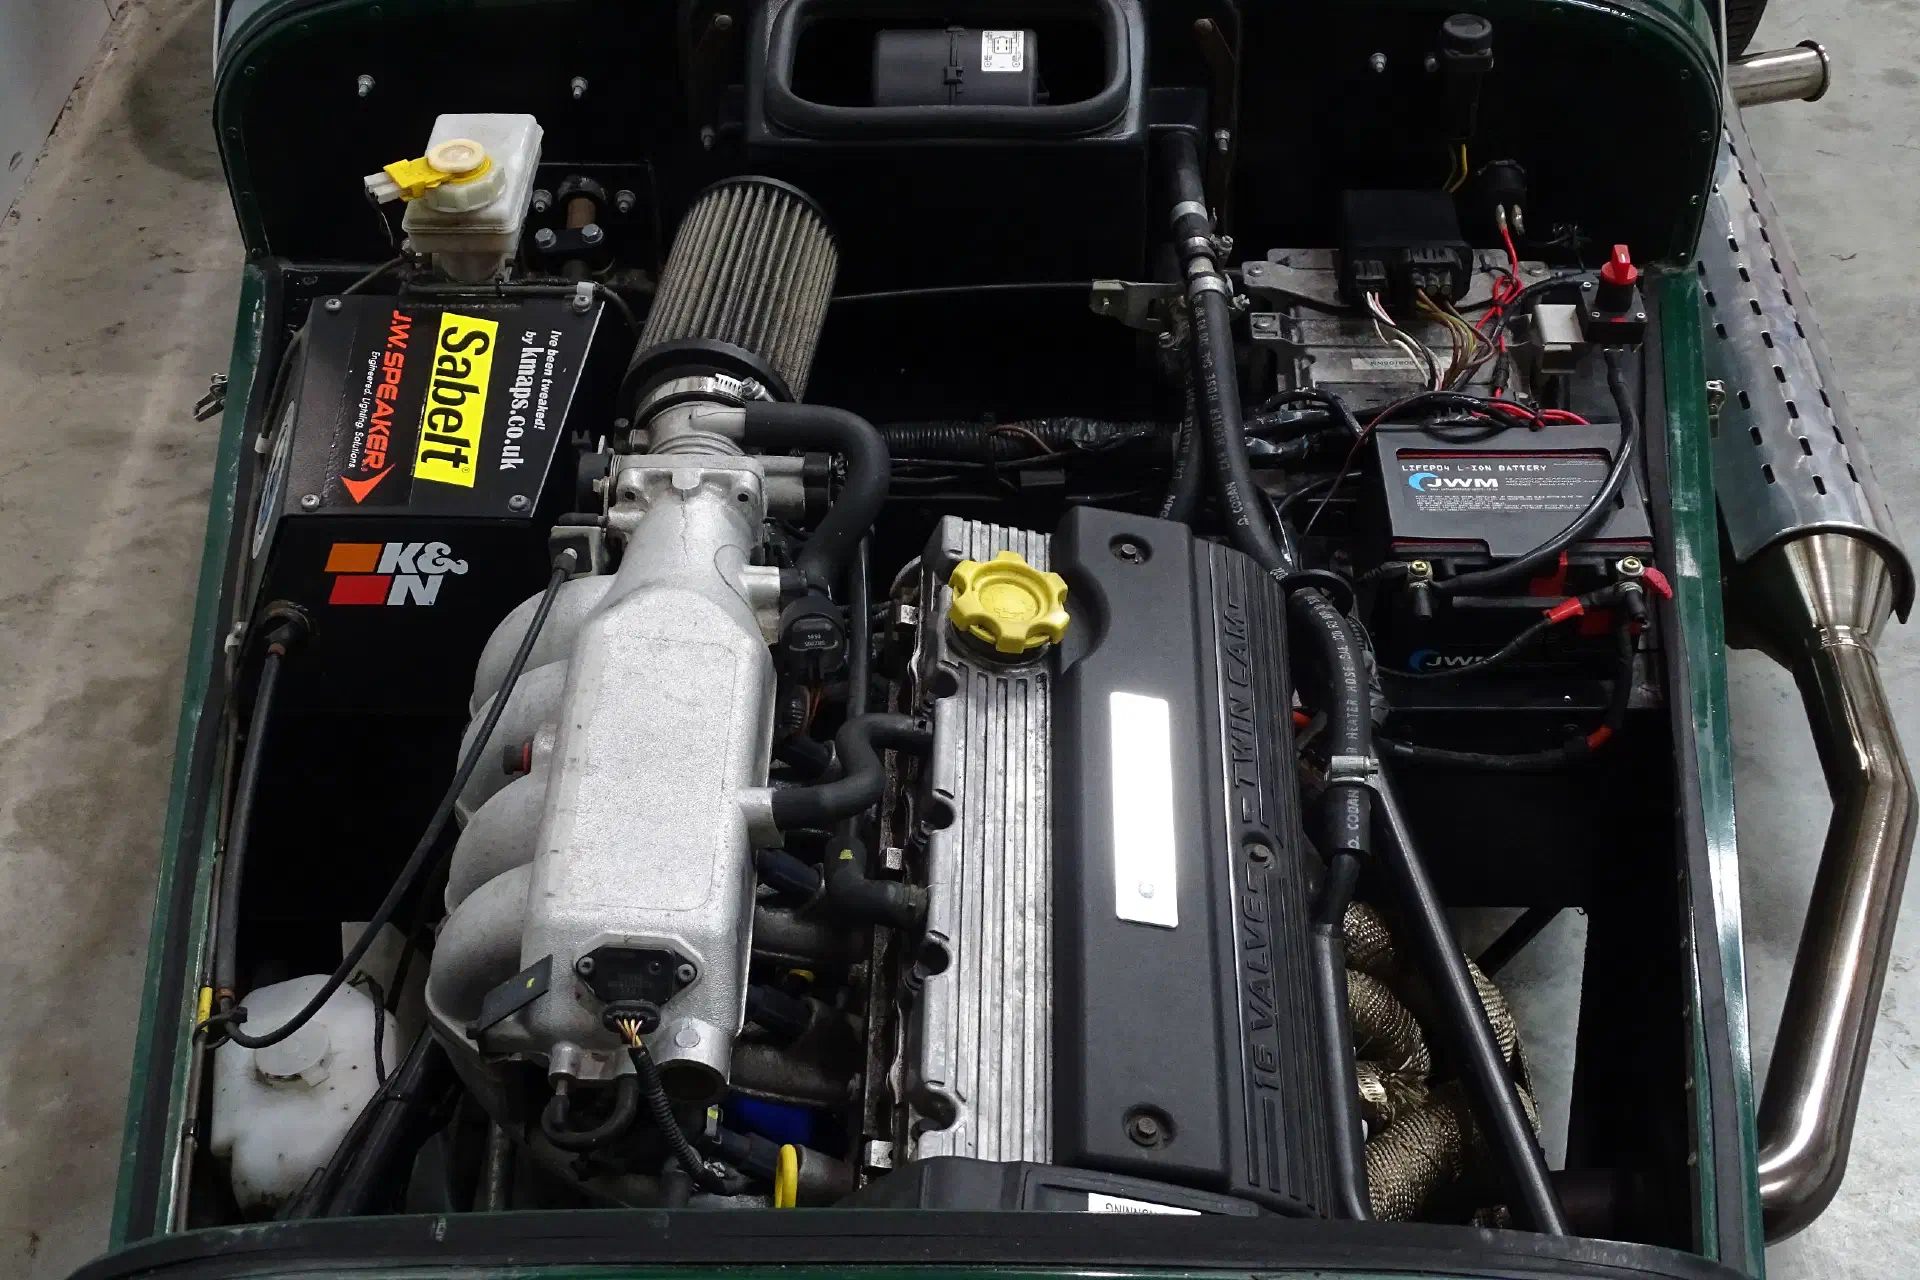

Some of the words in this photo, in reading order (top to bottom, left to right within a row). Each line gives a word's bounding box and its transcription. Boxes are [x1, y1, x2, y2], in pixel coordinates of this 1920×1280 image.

[387, 310, 412, 349] J.W.
[521, 331, 537, 345] by
[364, 351, 380, 396] Engineered.
[543, 349, 559, 376] been
[421, 326, 490, 469] Sabelt
[534, 378, 553, 431] tweaked!
[1206, 373, 1219, 400] HOSE
[363, 351, 405, 470] SPEAKER
[499, 347, 545, 471] kmaps.co.uk
[348, 431, 364, 469] Solutions.
[1498, 464, 1547, 472] BATTERY
[1426, 478, 1499, 488] JWM
[1160, 494, 1176, 518] DAN
[1224, 609, 1249, 687] CAM
[1343, 665, 1357, 692] HOSE
[1346, 699, 1359, 740] HEATER
[1228, 693, 1256, 789] TWIN
[1347, 789, 1360, 831] CODAN
[1253, 1043, 1280, 1090] 16
